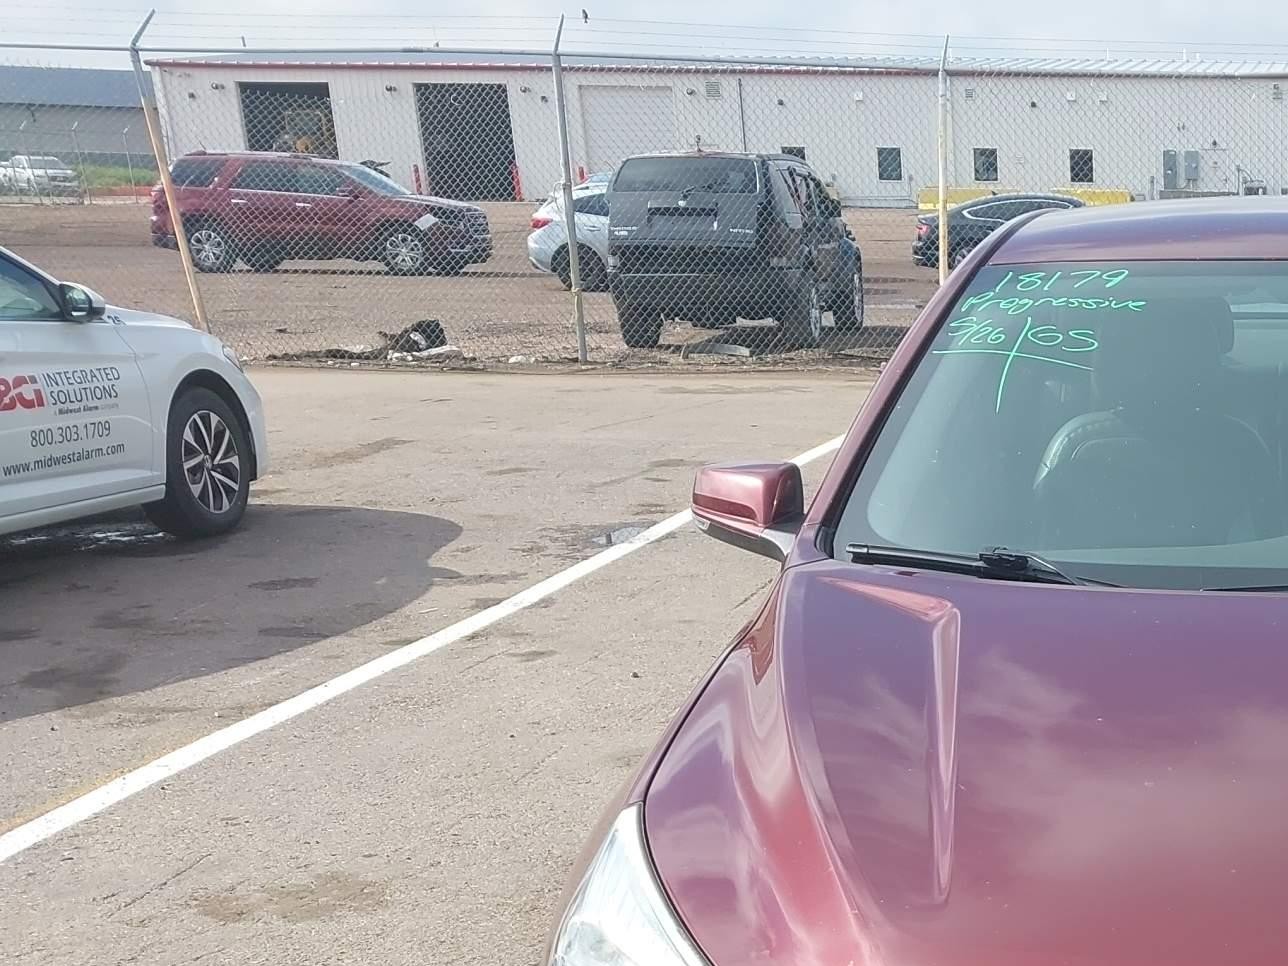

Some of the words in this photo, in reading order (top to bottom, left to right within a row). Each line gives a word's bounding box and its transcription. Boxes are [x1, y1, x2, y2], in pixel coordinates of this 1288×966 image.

[995, 269, 1129, 293] 18179
[960, 290, 1147, 315] Progressive
[42, 366, 120, 388] INTEGRATED
[49, 383, 119, 406] SOLUTIONS
[30, 420, 111, 448] 800.303.1709
[2, 443, 125, 477] www.midwestalarm.com
